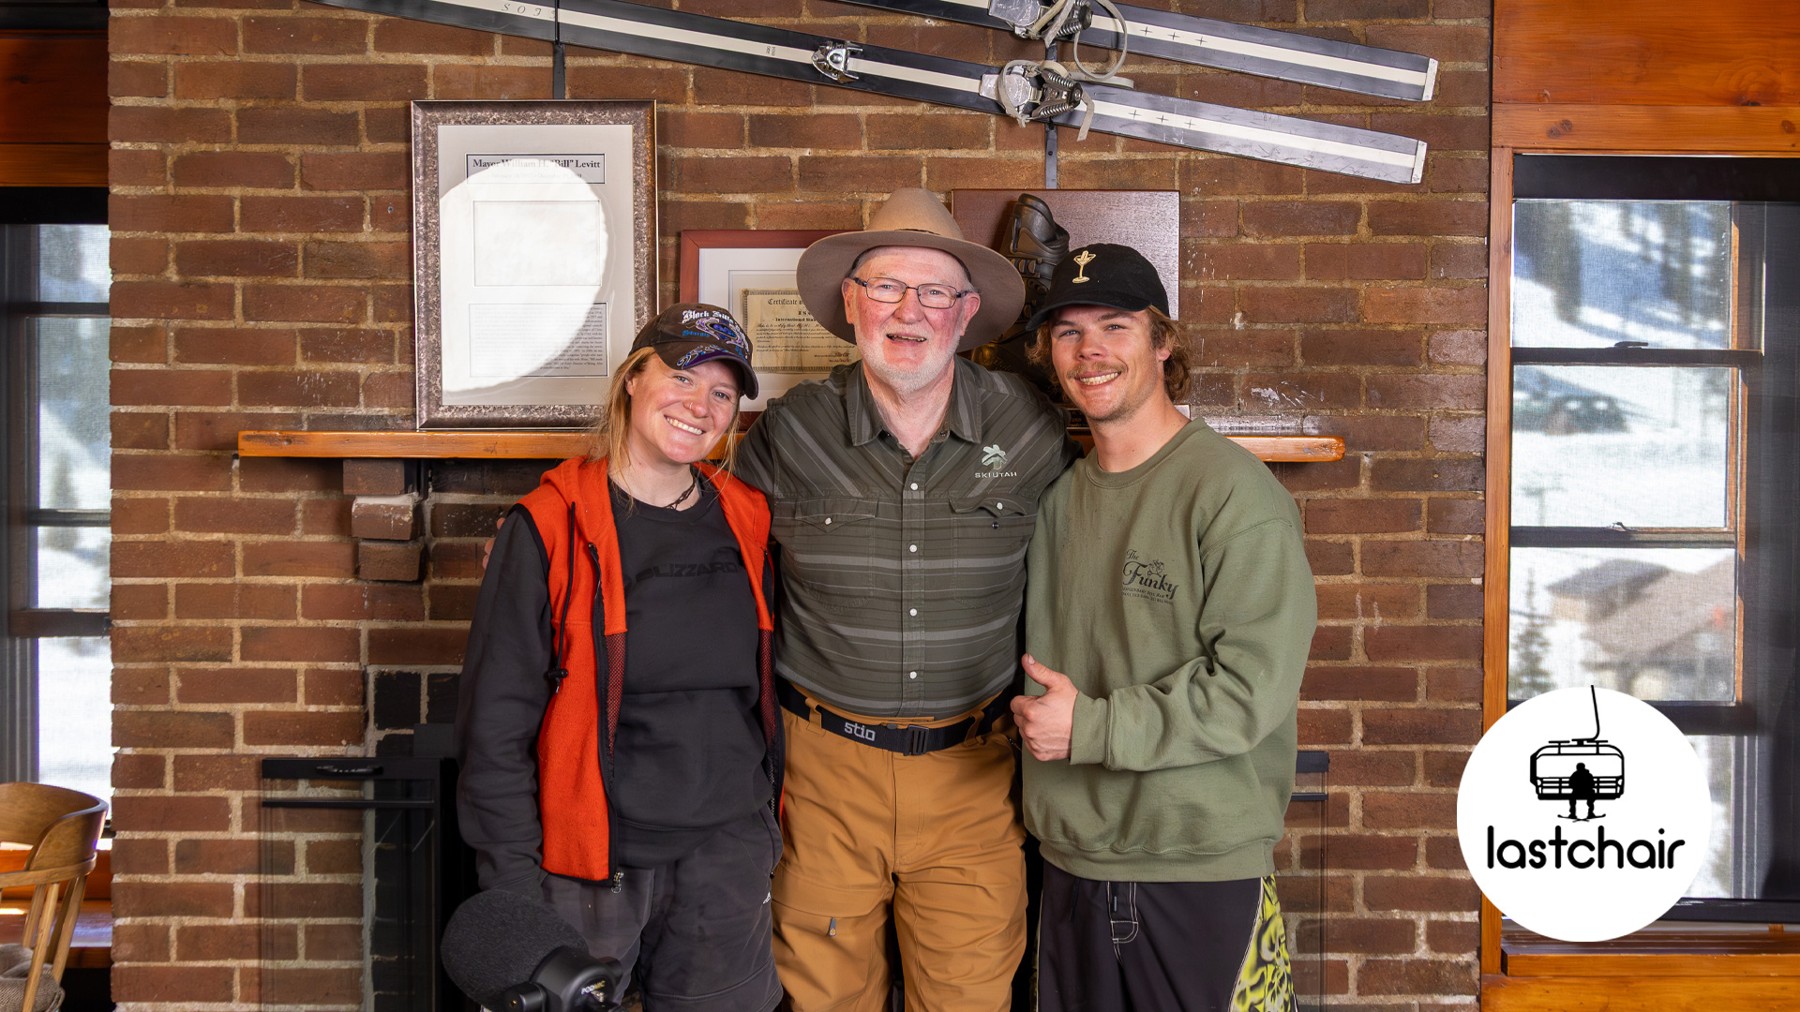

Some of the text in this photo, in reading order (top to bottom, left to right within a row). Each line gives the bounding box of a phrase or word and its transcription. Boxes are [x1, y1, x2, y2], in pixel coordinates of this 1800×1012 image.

[575, 159, 600, 168] Levitt
[1126, 549, 1140, 560] The
[1122, 560, 1180, 600] Funky
[844, 721, 876, 742] stio
